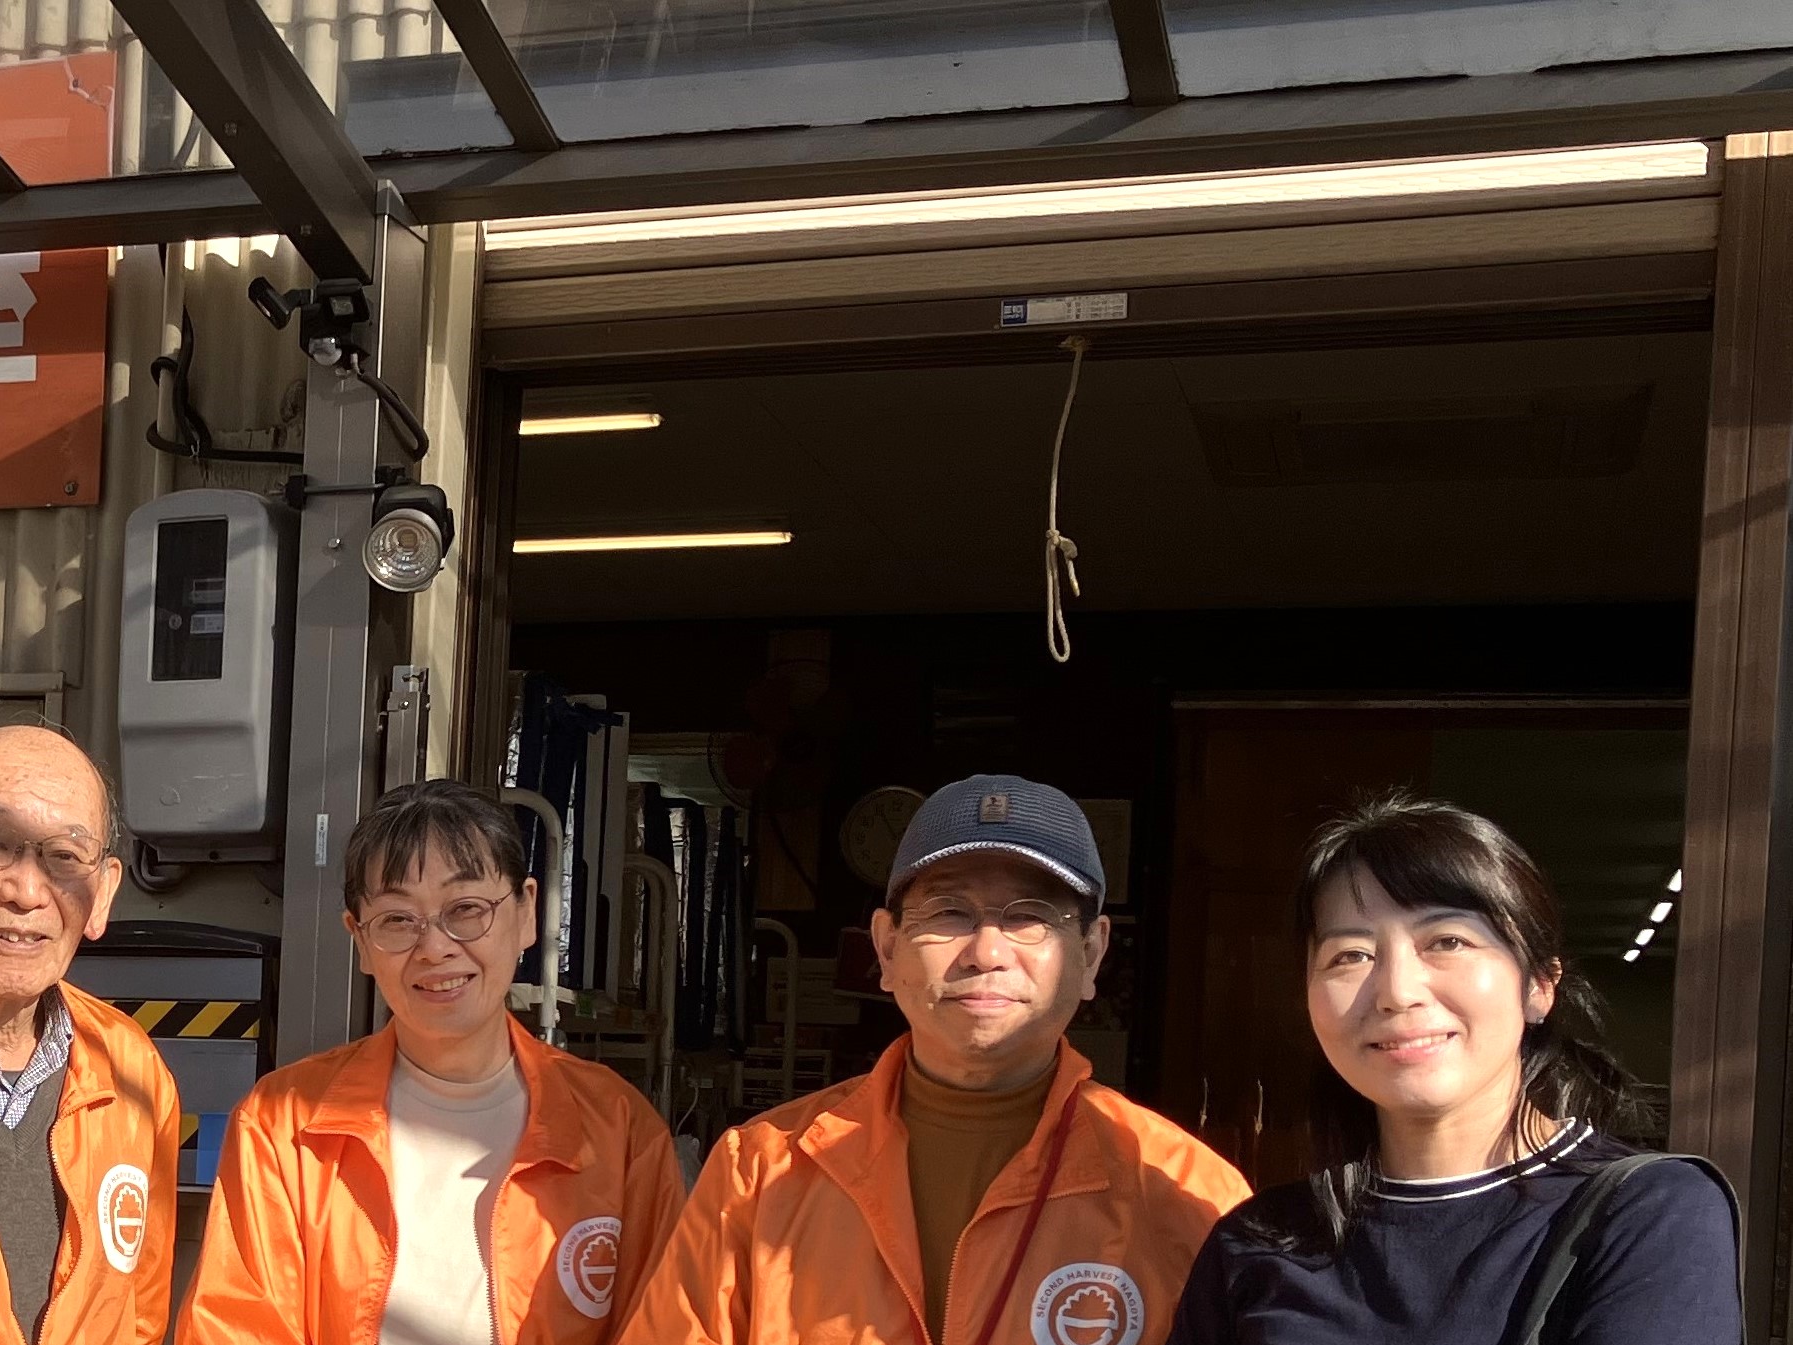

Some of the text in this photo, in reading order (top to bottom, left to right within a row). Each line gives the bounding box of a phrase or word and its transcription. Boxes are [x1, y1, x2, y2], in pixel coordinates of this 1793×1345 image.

[1036, 1269, 1138, 1331] SECOND HARVEST NAGOYA
